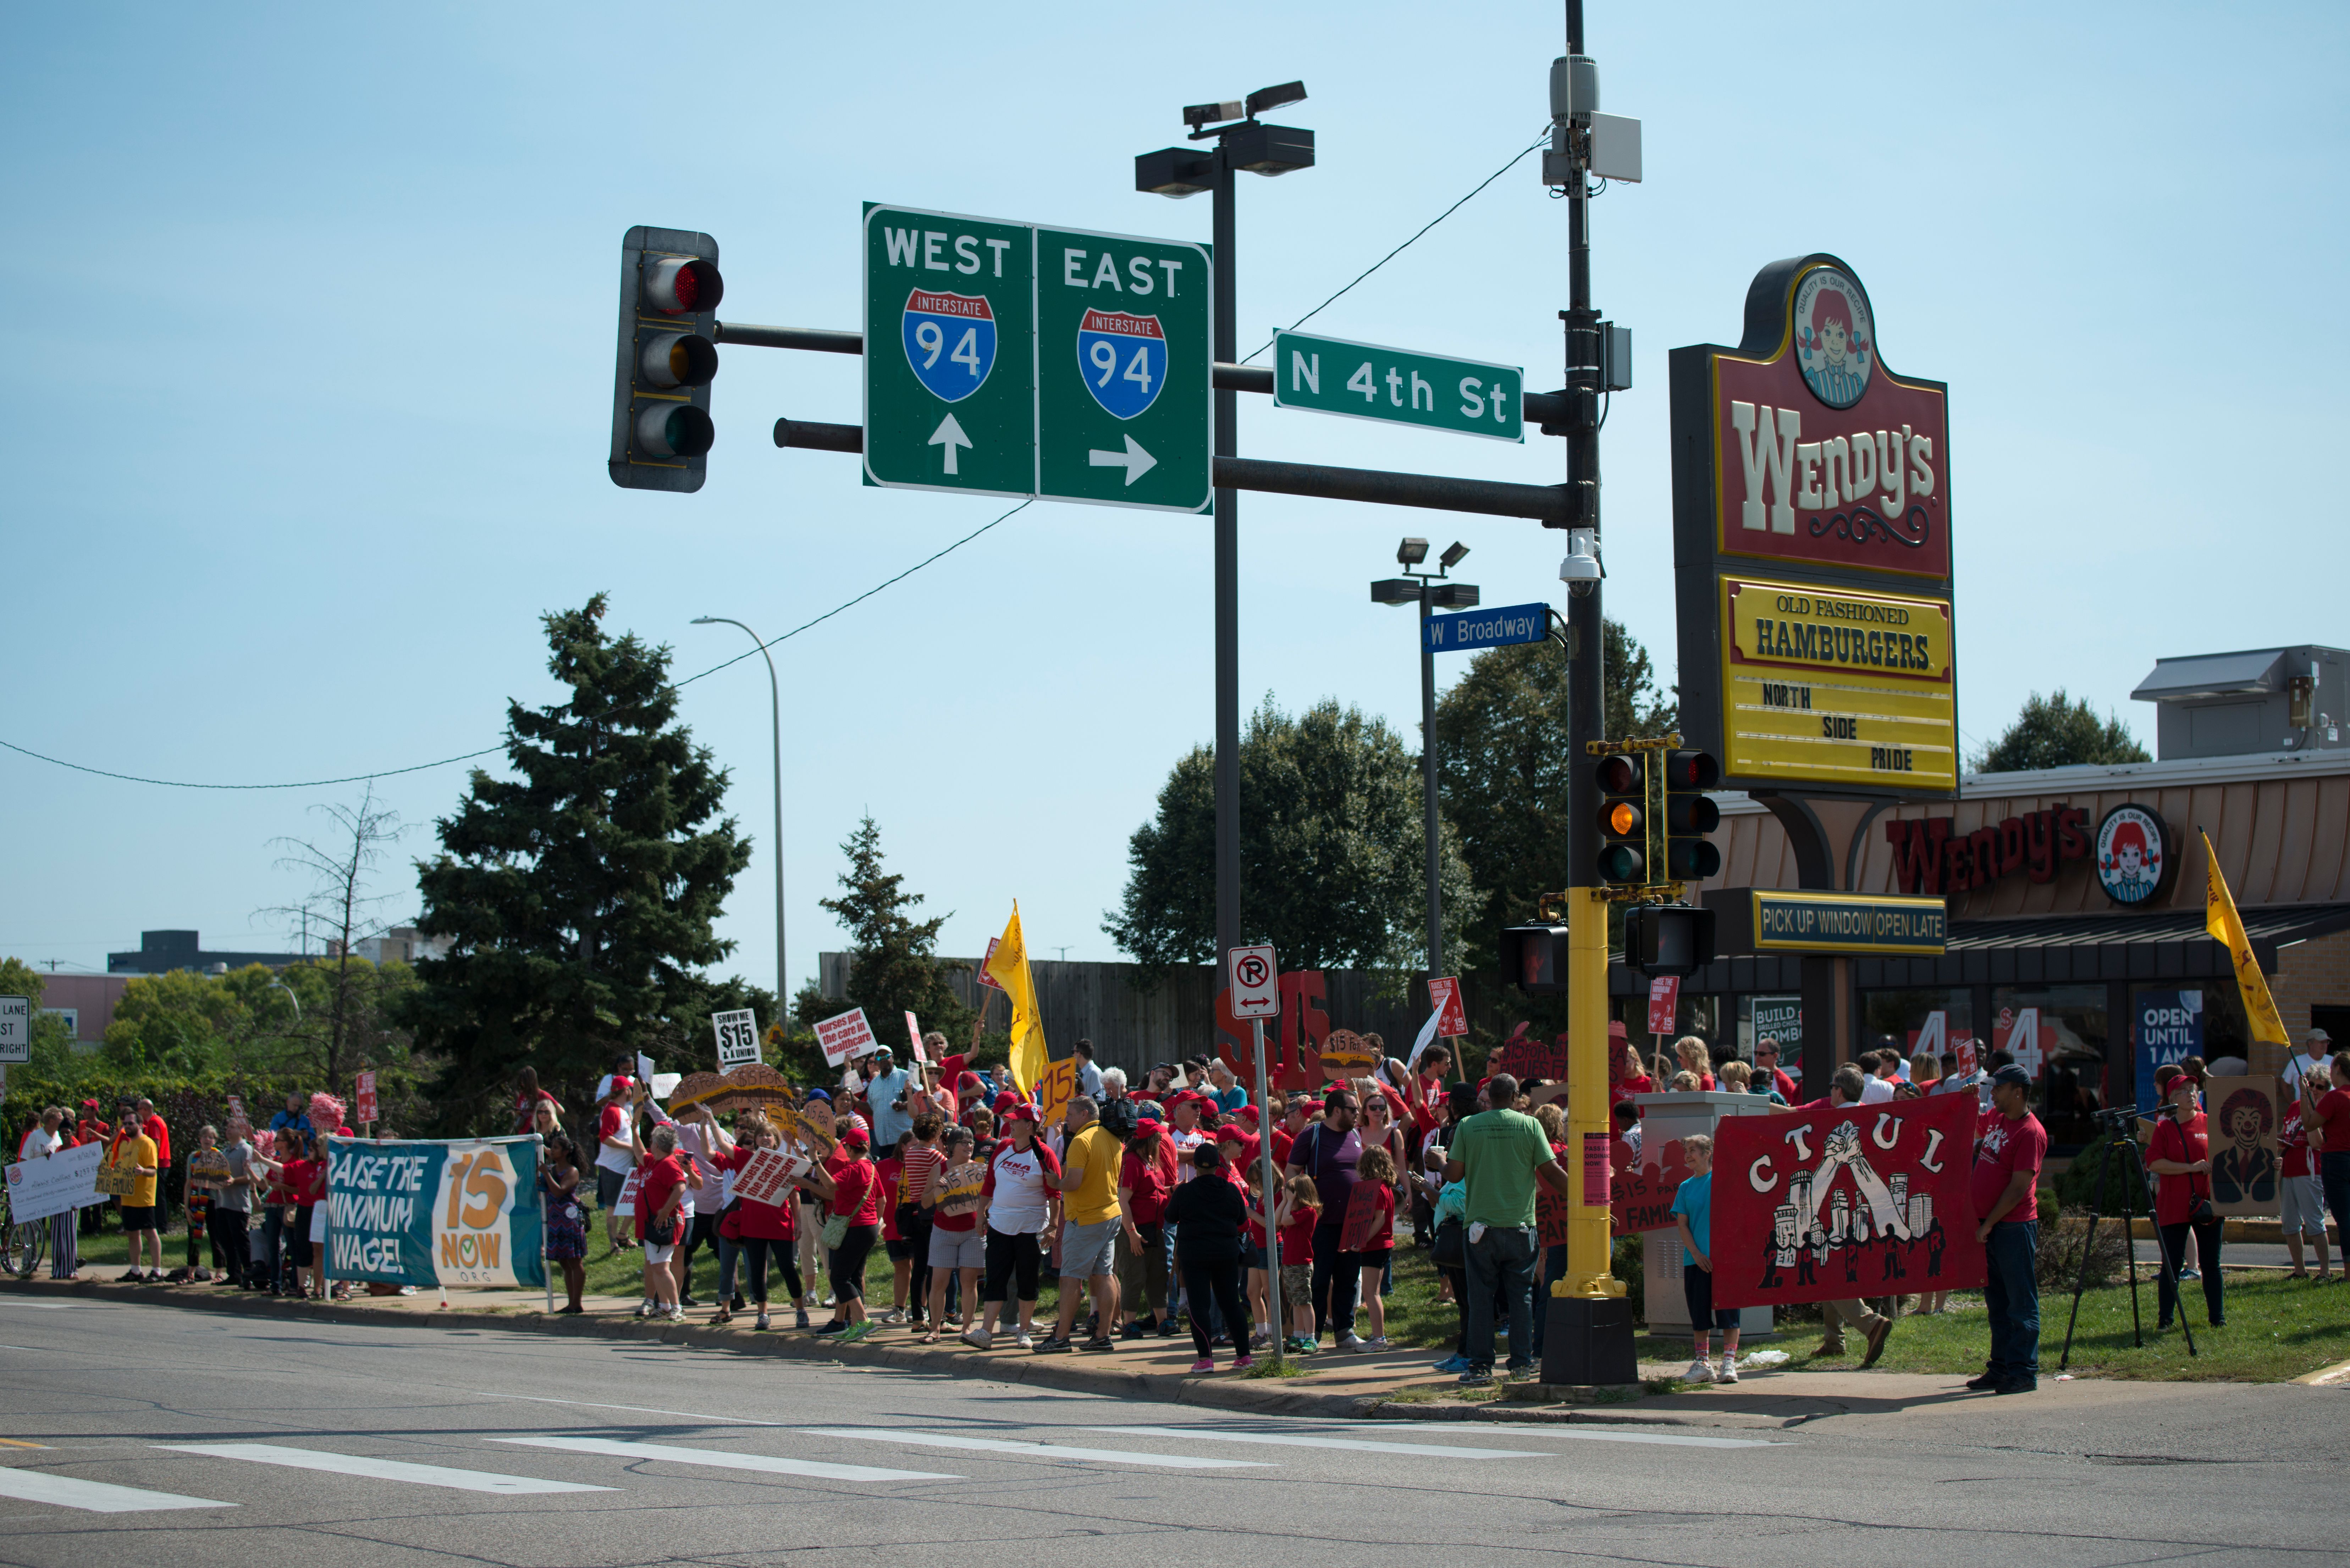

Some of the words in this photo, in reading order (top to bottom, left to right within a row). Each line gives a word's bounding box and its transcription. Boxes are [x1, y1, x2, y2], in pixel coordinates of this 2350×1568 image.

[884, 227, 1010, 278] WEST
[1064, 248, 1182, 298] EAST
[917, 296, 981, 316] INTERSTATE
[1798, 278, 1818, 314] QUALITY
[1819, 276, 1827, 285] IS
[1830, 277, 1845, 290] OUR
[1846, 288, 1866, 324] RECIPE
[1091, 316, 1153, 335] INTERSTATE
[916, 321, 980, 376] 94
[1090, 340, 1152, 393] 94
[1292, 350, 1319, 394] N
[1347, 362, 1433, 411] 4th
[1459, 377, 1506, 423] St
[1777, 595, 1810, 614] OLD
[1815, 599, 1909, 625] FASHIONED
[1431, 622, 1444, 645] W
[1458, 615, 1535, 642] Broadway
[1756, 618, 1929, 670] HAMBURGERS
[1762, 683, 1811, 709] NORTH
[1823, 716, 1857, 740] SIDE
[1871, 747, 1912, 771] PRIDE
[2101, 818, 2117, 848] QUALITY
[2128, 812, 2142, 821] OUR
[2142, 818, 2158, 844] RECIPE
[1763, 908, 1794, 932] PICK
[1797, 910, 1814, 933] UP
[1817, 910, 1872, 935] WINDOW
[1876, 913, 1909, 936] OPEN
[1913, 914, 1942, 937] LATE
[1430, 981, 1444, 990] RAISE
[1443, 979, 1452, 988] THE
[1432, 987, 1452, 997] MINIMUM
[1652, 985, 1670, 993] MINIMUM
[1665, 978, 1673, 986] THE
[1651, 993, 1662, 1001] WAGE
[4, 1005, 26, 1015] LANE
[717, 1012, 738, 1024] SHOW
[739, 1011, 749, 1021] ME
[1454, 1017, 1464, 1027] 15
[1663, 1016, 1672, 1026] 15
[1756, 1006, 1795, 1024] BUILD
[2145, 1008, 2194, 1027] OPEN
[818, 1017, 847, 1035] Nurses
[847, 1010, 862, 1025] put
[823, 1033, 837, 1045] the
[838, 1025, 856, 1039] care
[856, 1021, 866, 1032] in
[1757, 1021, 1781, 1031] GRILLED
[720, 1023, 753, 1050] $15
[827, 1032, 871, 1056] healthcare
[1330, 1035, 1346, 1053] $15
[1350, 1037, 1361, 1052] FOR
[1950, 1035, 1965, 1048] for
[2145, 1028, 2194, 1046] UNTIL
[723, 1051, 729, 1059] &
[731, 1050, 735, 1059] A
[736, 1047, 756, 1058] UNION
[1502, 1038, 1525, 1062] $15
[1525, 1044, 1547, 1061] FOR
[2149, 1047, 2157, 1064] 1
[2161, 1047, 2188, 1064] AM
[678, 1079, 697, 1099] $15
[699, 1076, 721, 1090] FOR
[737, 1070, 757, 1087] $15
[759, 1071, 782, 1085] FOR
[1044, 1063, 1072, 1113] 15
[231, 1100, 244, 1117] 15
[805, 1104, 817, 1119] $15
[817, 1111, 829, 1128] FOR
[385, 1156, 429, 1191] THE
[733, 1164, 761, 1194] Nurses
[754, 1150, 771, 1167] put
[746, 1182, 763, 1197] the
[758, 1163, 777, 1183] care
[769, 1154, 784, 1165] in
[1002, 1160, 1031, 1171] MNA
[447, 1151, 508, 1230] 15
[758, 1157, 798, 1202] healthcare
[940, 1172, 961, 1195] $15
[1611, 1179, 1647, 1202] $15
[328, 1192, 414, 1233] MINIMUM
[332, 1234, 404, 1274] WAGE!
[441, 1233, 501, 1268] NOW
